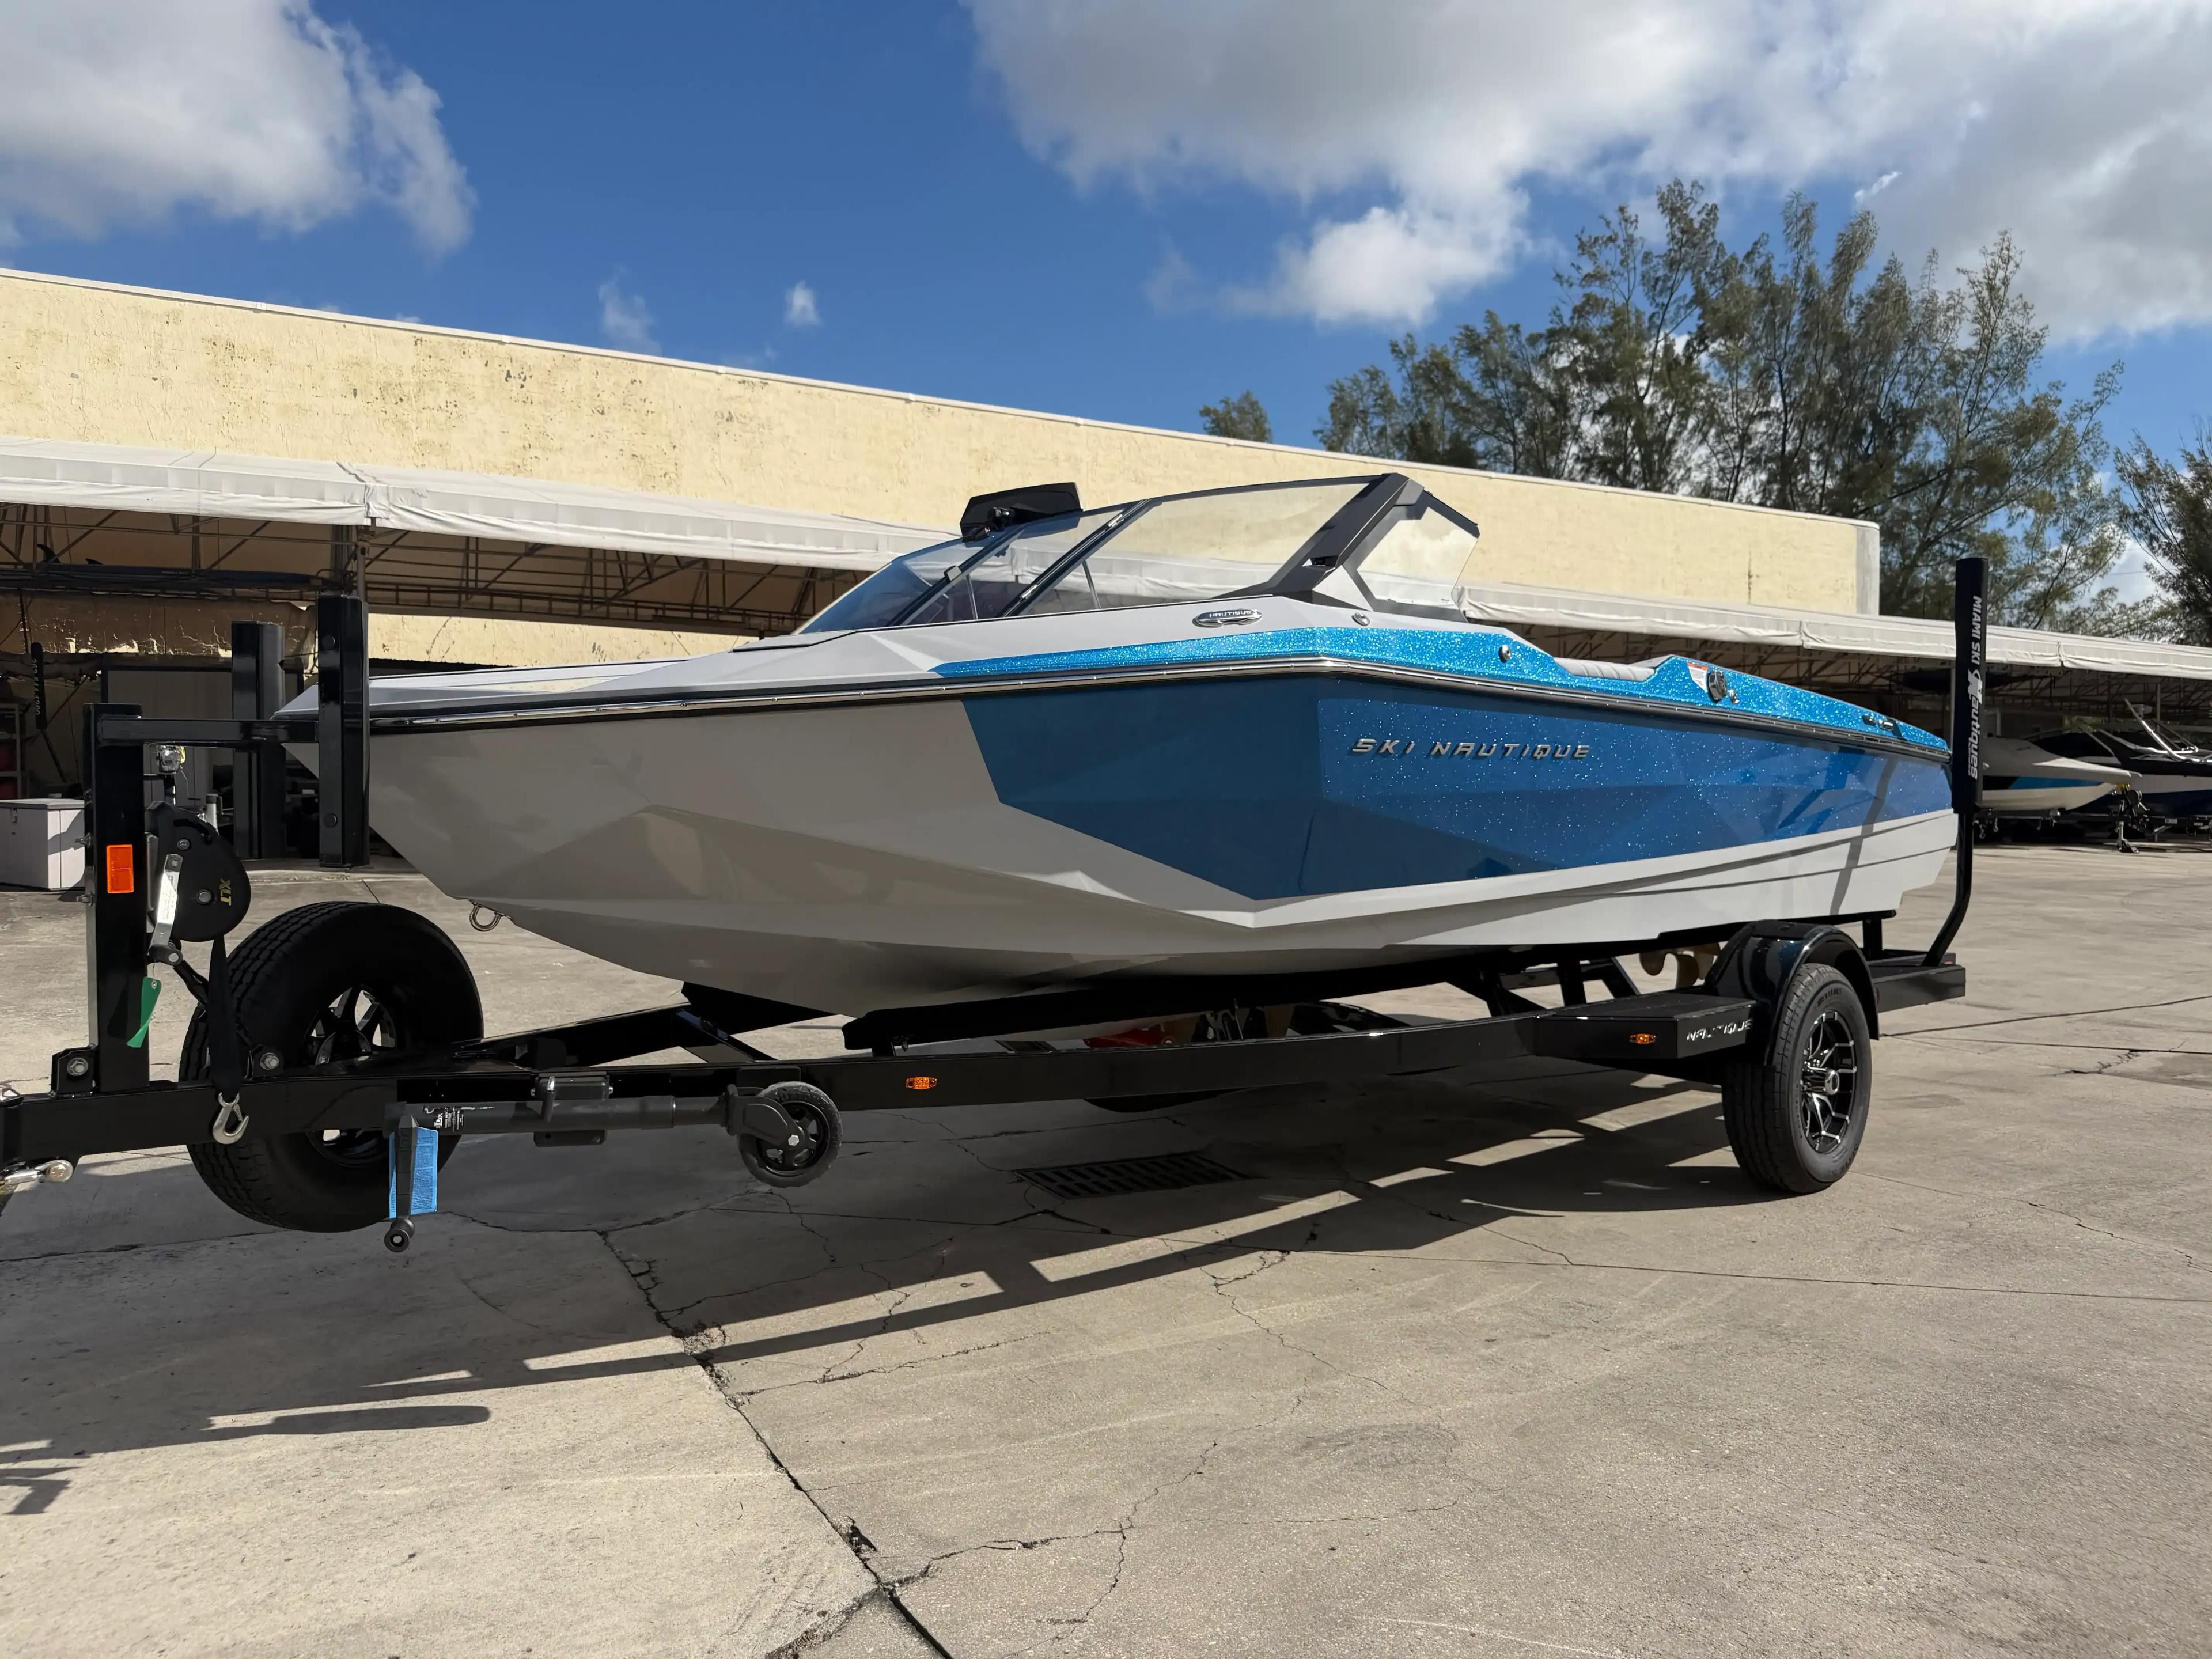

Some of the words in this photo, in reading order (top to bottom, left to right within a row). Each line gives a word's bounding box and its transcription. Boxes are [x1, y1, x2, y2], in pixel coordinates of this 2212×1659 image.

[1972, 595, 1982, 639] MIAMI
[1971, 641, 1980, 665] SKI
[1352, 738, 1415, 754] SKI
[1431, 741, 1590, 759] NAUTIQUE
[219, 878, 232, 906] XLT
